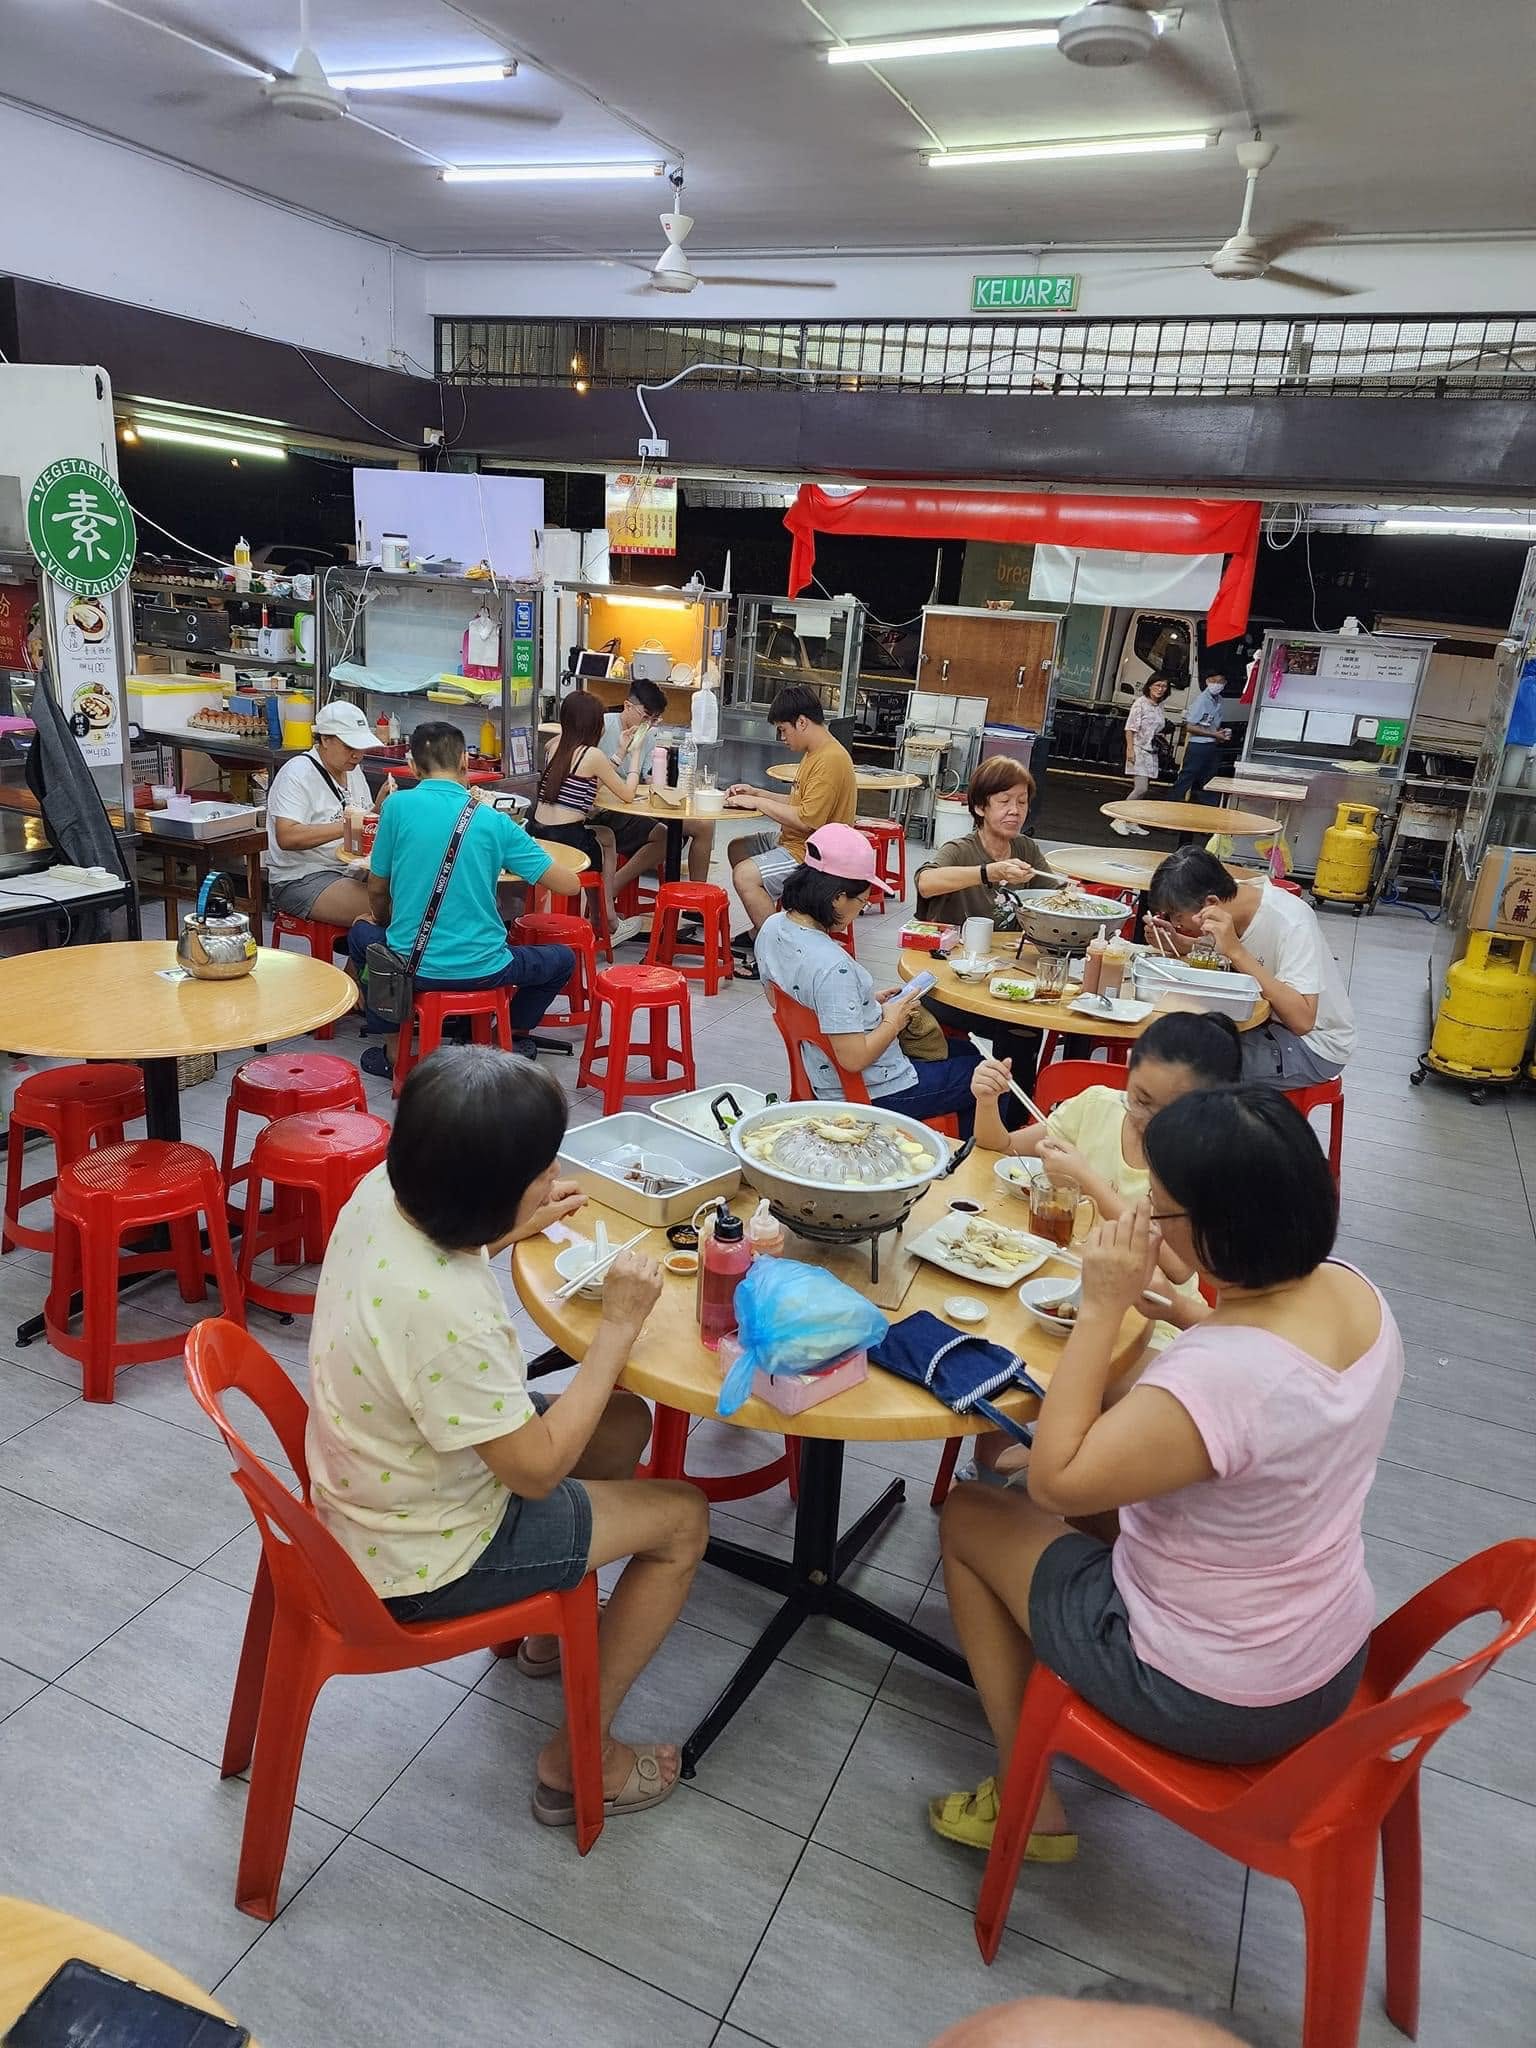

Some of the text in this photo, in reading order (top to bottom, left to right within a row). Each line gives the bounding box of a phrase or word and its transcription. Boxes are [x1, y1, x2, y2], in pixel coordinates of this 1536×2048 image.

[976, 279, 1052, 304] KELUAR
[34, 460, 121, 499] VEGETARIAN
[51, 488, 118, 563] 素
[46, 558, 129, 595] VEGETARIAN
[516, 651, 530, 661] Grab
[517, 662, 528, 672] Pay
